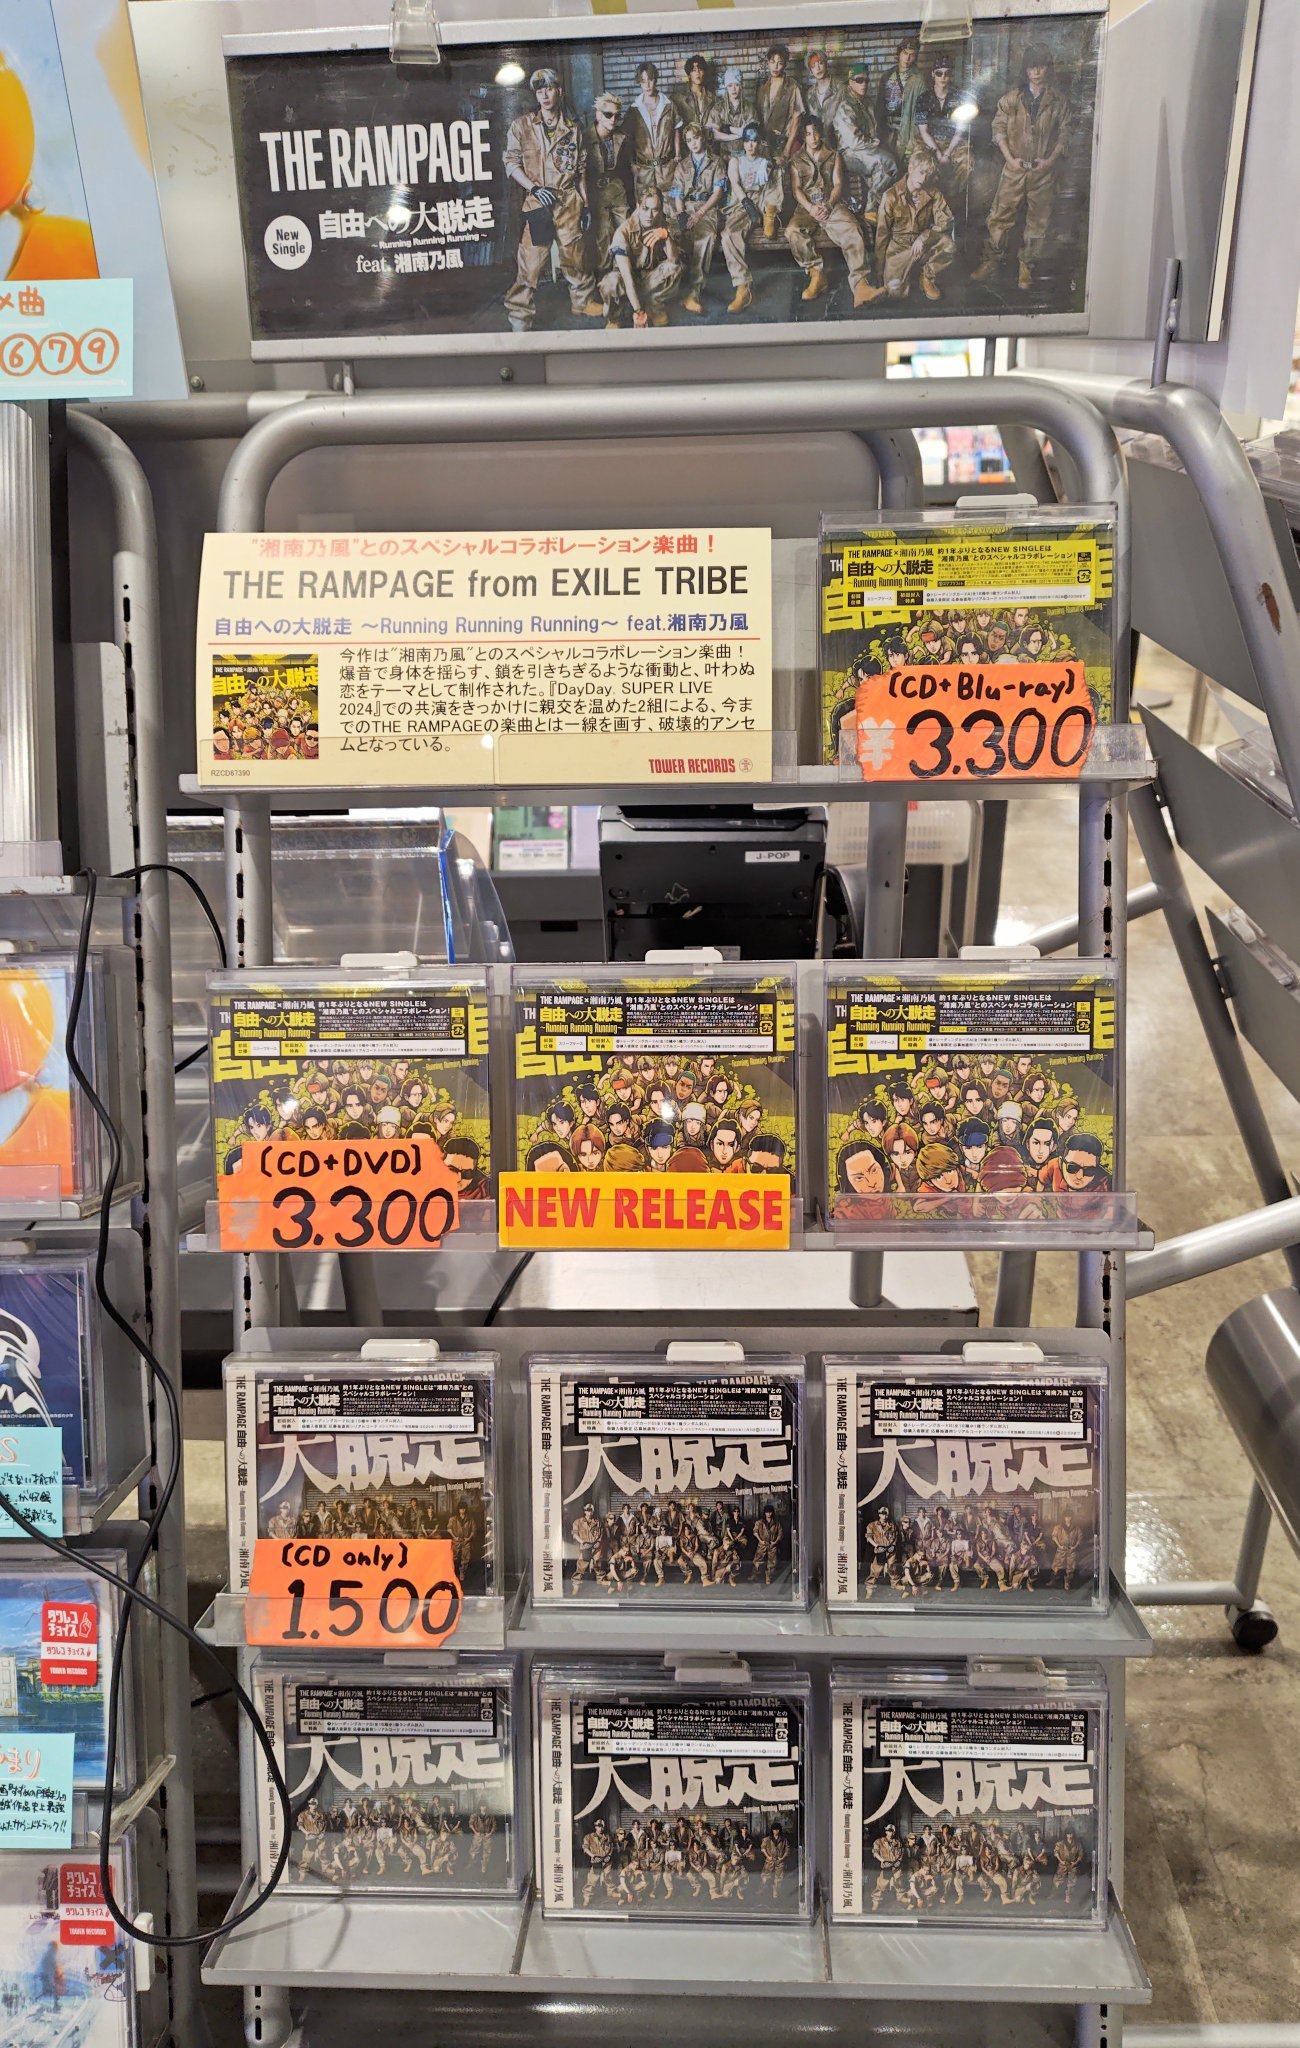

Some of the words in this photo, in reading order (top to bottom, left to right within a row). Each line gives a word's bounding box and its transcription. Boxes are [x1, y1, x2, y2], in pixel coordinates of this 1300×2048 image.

[260, 129, 326, 192] THE
[329, 120, 493, 189] RAMPAGE
[318, 196, 494, 240] 自由への大脱走
[276, 228, 299, 241] New
[413, 236, 446, 247] Running
[272, 242, 305, 258] Single
[356, 256, 391, 273] feat.
[394, 249, 464, 274] 湘南乃風
[848, 550, 860, 559] THE
[848, 559, 934, 577] 自由への大脱走
[223, 569, 285, 600] THE
[297, 568, 454, 599] RAMPAGE
[468, 568, 537, 598] from
[551, 567, 641, 597] EXILE
[655, 565, 748, 596] TRIBE
[878, 577, 902, 588] Running
[215, 616, 352, 636] 自由への大脱走
[455, 615, 523, 635] Running
[621, 681, 674, 695] SUPER
[679, 681, 713, 694] LIVE
[888, 668, 1075, 703] (CD+Blu-ray)
[340, 738, 451, 754] ムとなっている。
[905, 705, 1091, 779] 3.300
[648, 758, 686, 774] TOWER
[688, 758, 736, 774] RECORDS
[234, 1001, 246, 1010] THE
[540, 996, 553, 1005] THE
[850, 993, 863, 1003] THE
[233, 1011, 316, 1028] 自由への大脱走
[540, 1006, 623, 1023] 自由への大脱走
[850, 1004, 936, 1021] 自由への大脱走
[263, 1028, 286, 1039] Running
[569, 1023, 593, 1034] Running
[881, 1021, 905, 1032] Running
[260, 1143, 422, 1177] (CD+DVD)
[505, 1187, 600, 1228] NEW
[614, 1188, 783, 1231] RELEASE
[272, 1186, 455, 1249] 3.300
[578, 1387, 588, 1395] THE
[272, 1394, 340, 1407] 自由への大脱走
[578, 1396, 646, 1409] 自由への大脱走
[874, 1397, 943, 1411] 自由への大脱走
[236, 1392, 247, 1428] RAMPAGE
[540, 1394, 552, 1431] RAMPAGE
[836, 1394, 848, 1431] RAMPAGE
[282, 1543, 331, 1567] (CD
[342, 1543, 408, 1570] only)
[282, 1578, 459, 1639] 1.500
[47, 1610, 78, 1625] タワレコ
[47, 1623, 78, 1637] チョイス
[46, 1646, 66, 1655] タワレコ
[67, 1647, 86, 1656] チョイス
[587, 1716, 654, 1730] 自由への大脱走
[880, 1720, 948, 1734] 自由への大脱走
[552, 1714, 562, 1749] RAMPAGE
[843, 1717, 853, 1753] RAMPAGE
[66, 1872, 97, 1885] タワレコ
[66, 1885, 97, 1898] チョイス
[65, 1907, 85, 1916] タワレコ
[85, 1908, 104, 1917] チョイス
